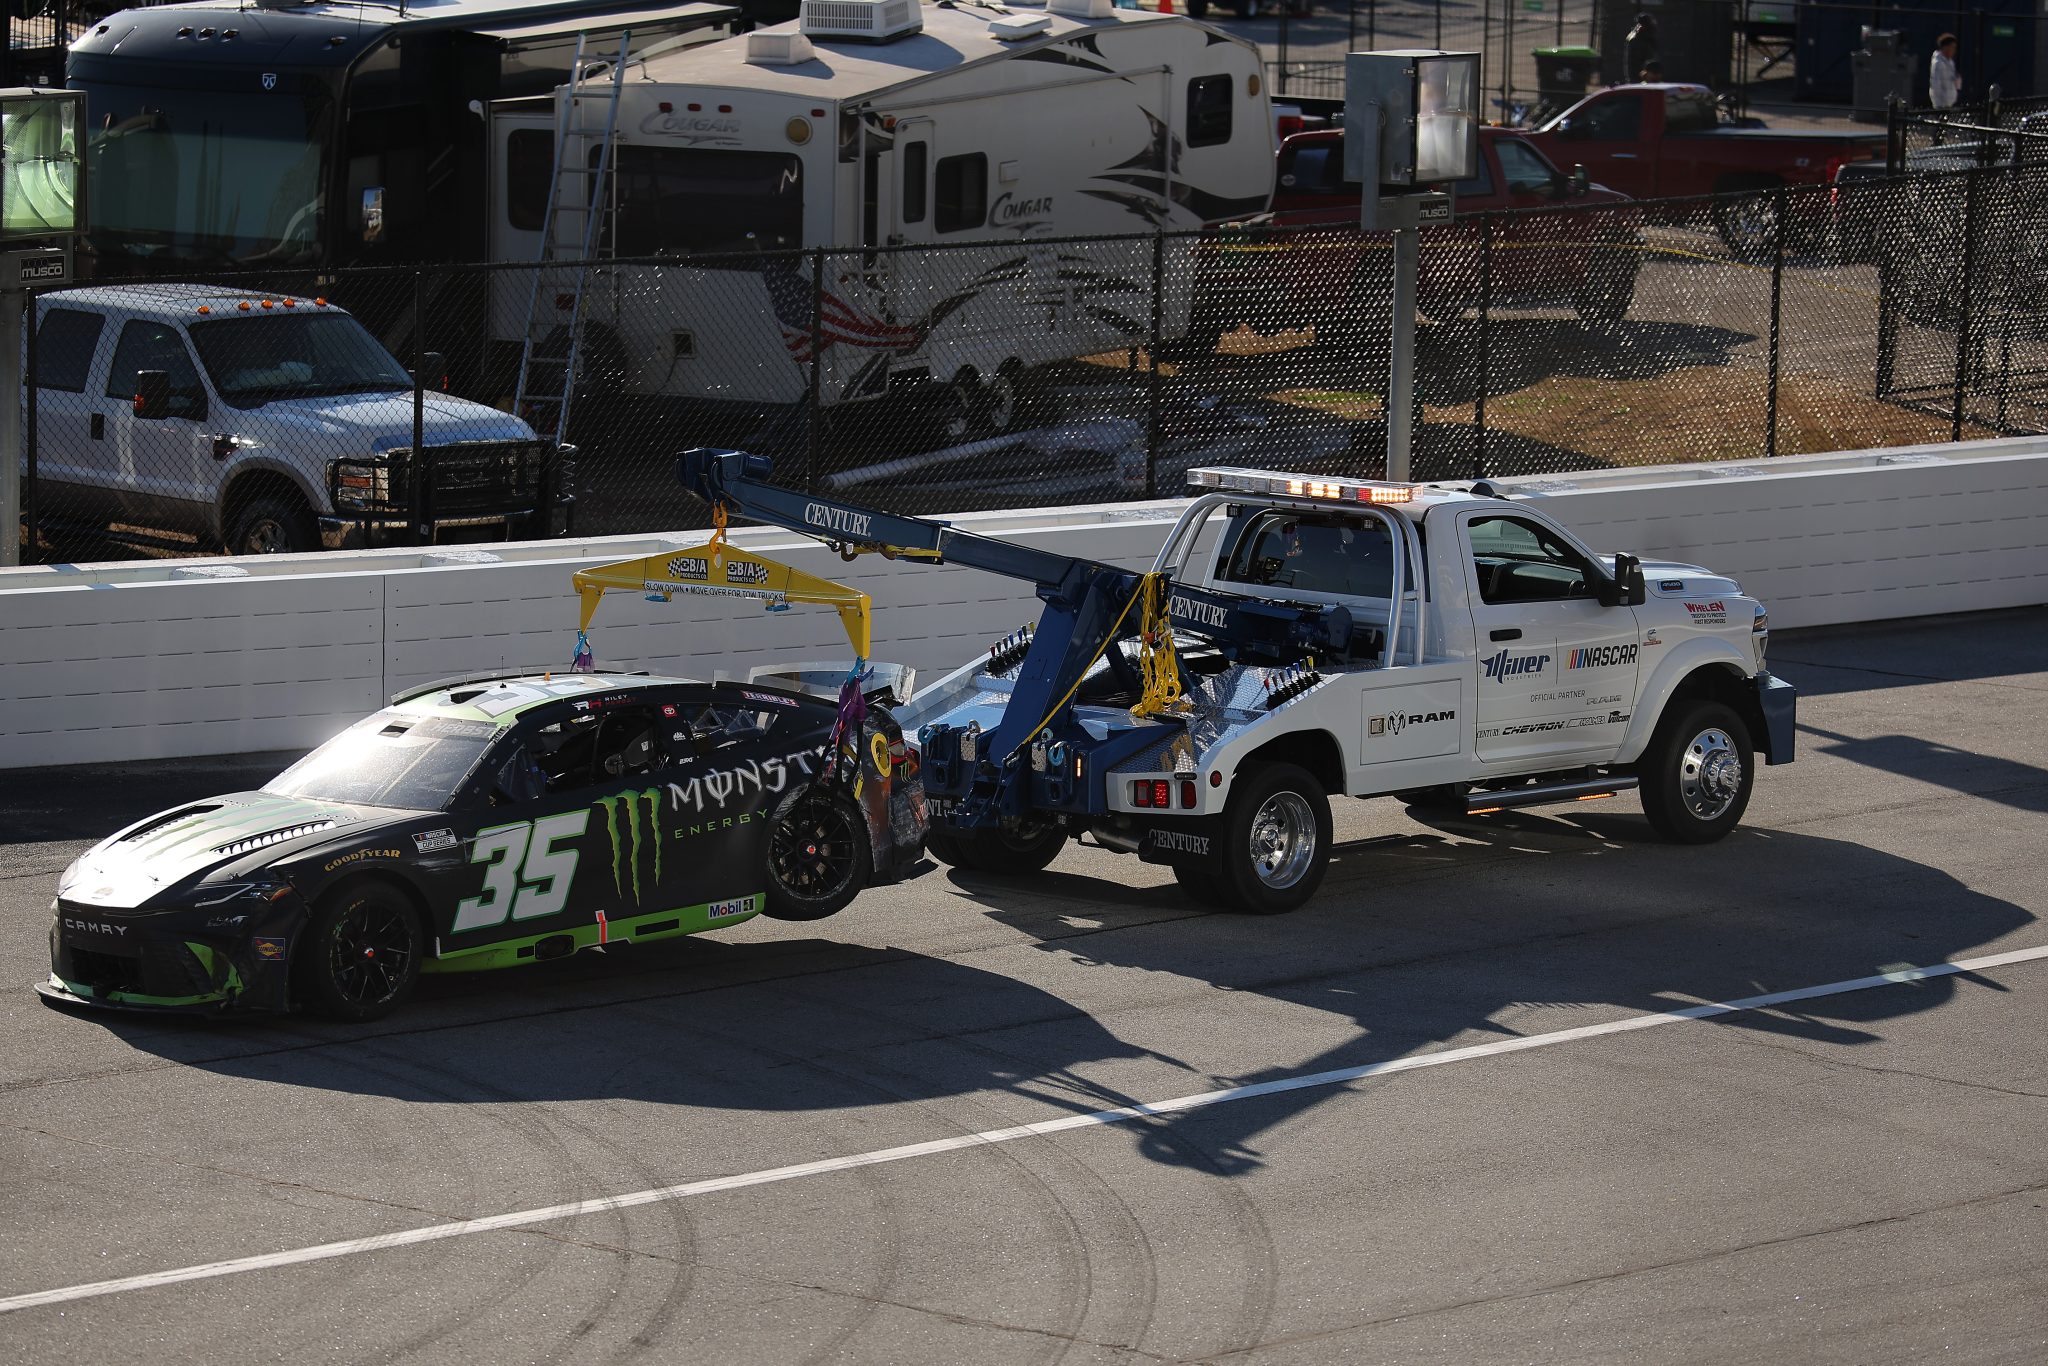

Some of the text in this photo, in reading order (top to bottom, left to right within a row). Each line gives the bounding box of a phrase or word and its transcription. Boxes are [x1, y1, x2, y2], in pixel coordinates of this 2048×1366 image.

[804, 502, 871, 537] CENTURY
[646, 582, 783, 601] SLOW DOWN MOVE OVER FOR TOW TRUCKS
[1168, 594, 1228, 628] CENTURY
[1684, 600, 1726, 613] WHELEN
[1582, 643, 1638, 668] NASCAR
[1530, 690, 1585, 703] OFFICIAL PARTNER
[1408, 710, 1455, 724] RAM
[1502, 720, 1564, 736] CHEVRON
[674, 808, 768, 839] ENERGY
[451, 808, 591, 934] 35
[709, 900, 741, 918] Mobil
[65, 918, 128, 936] CAMRY
